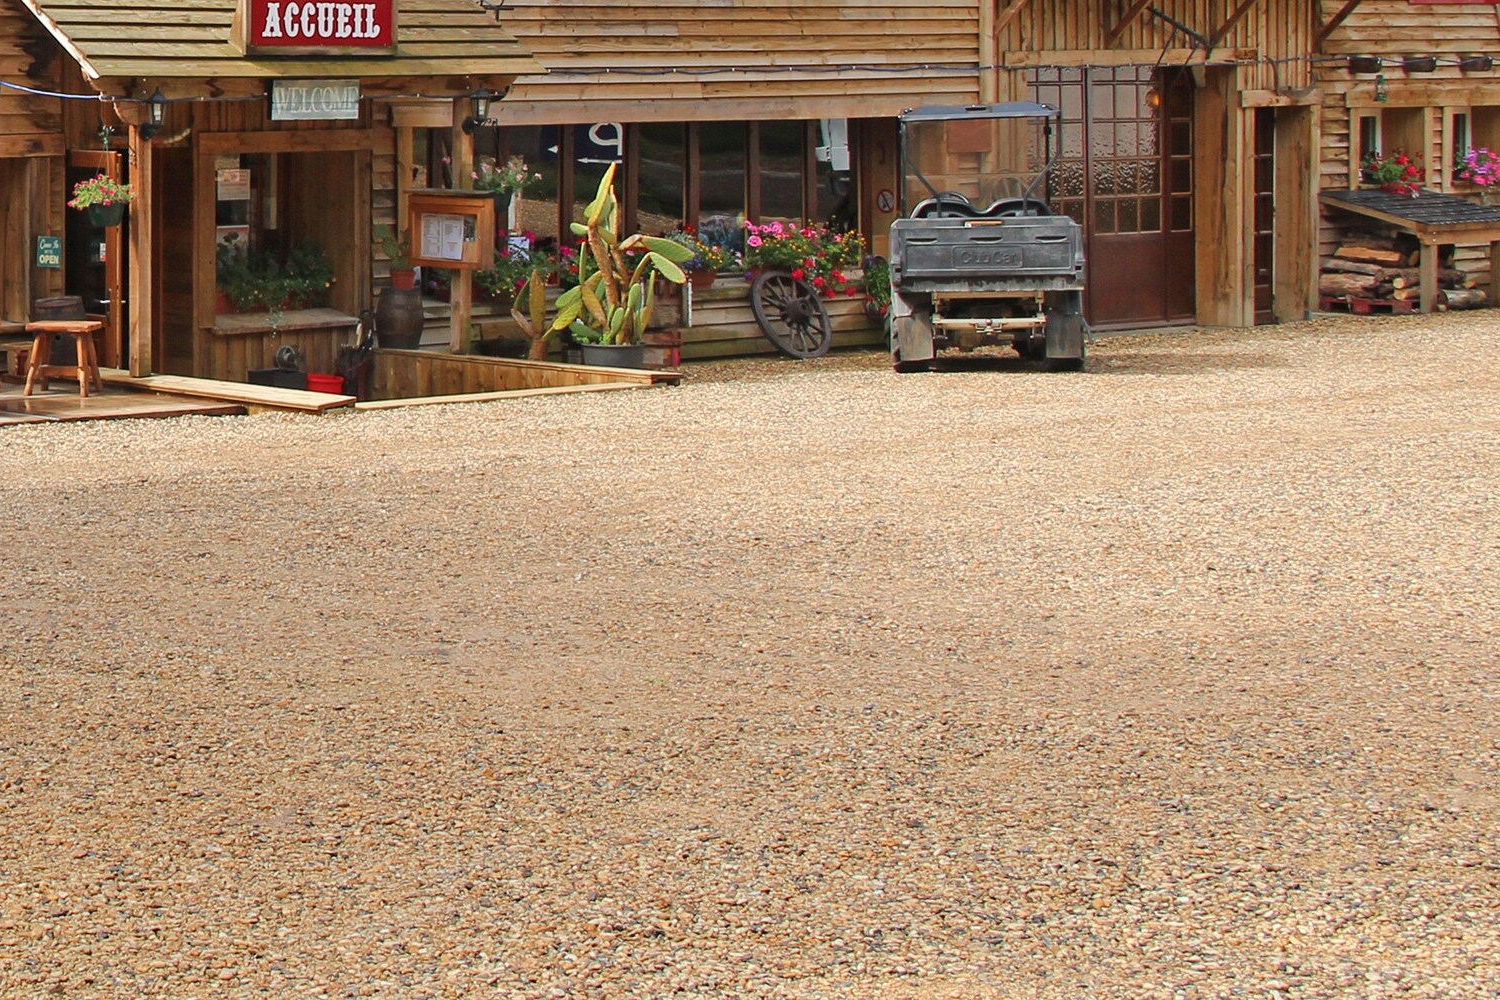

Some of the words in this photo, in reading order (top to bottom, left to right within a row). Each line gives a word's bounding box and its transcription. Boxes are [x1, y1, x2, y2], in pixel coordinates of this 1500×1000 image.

[262, 1, 381, 38] ACCUEIL
[274, 86, 359, 114] WELCOME
[39, 254, 59, 265] OPEN
[961, 249, 991, 264] Club
[993, 250, 1017, 264] Car
